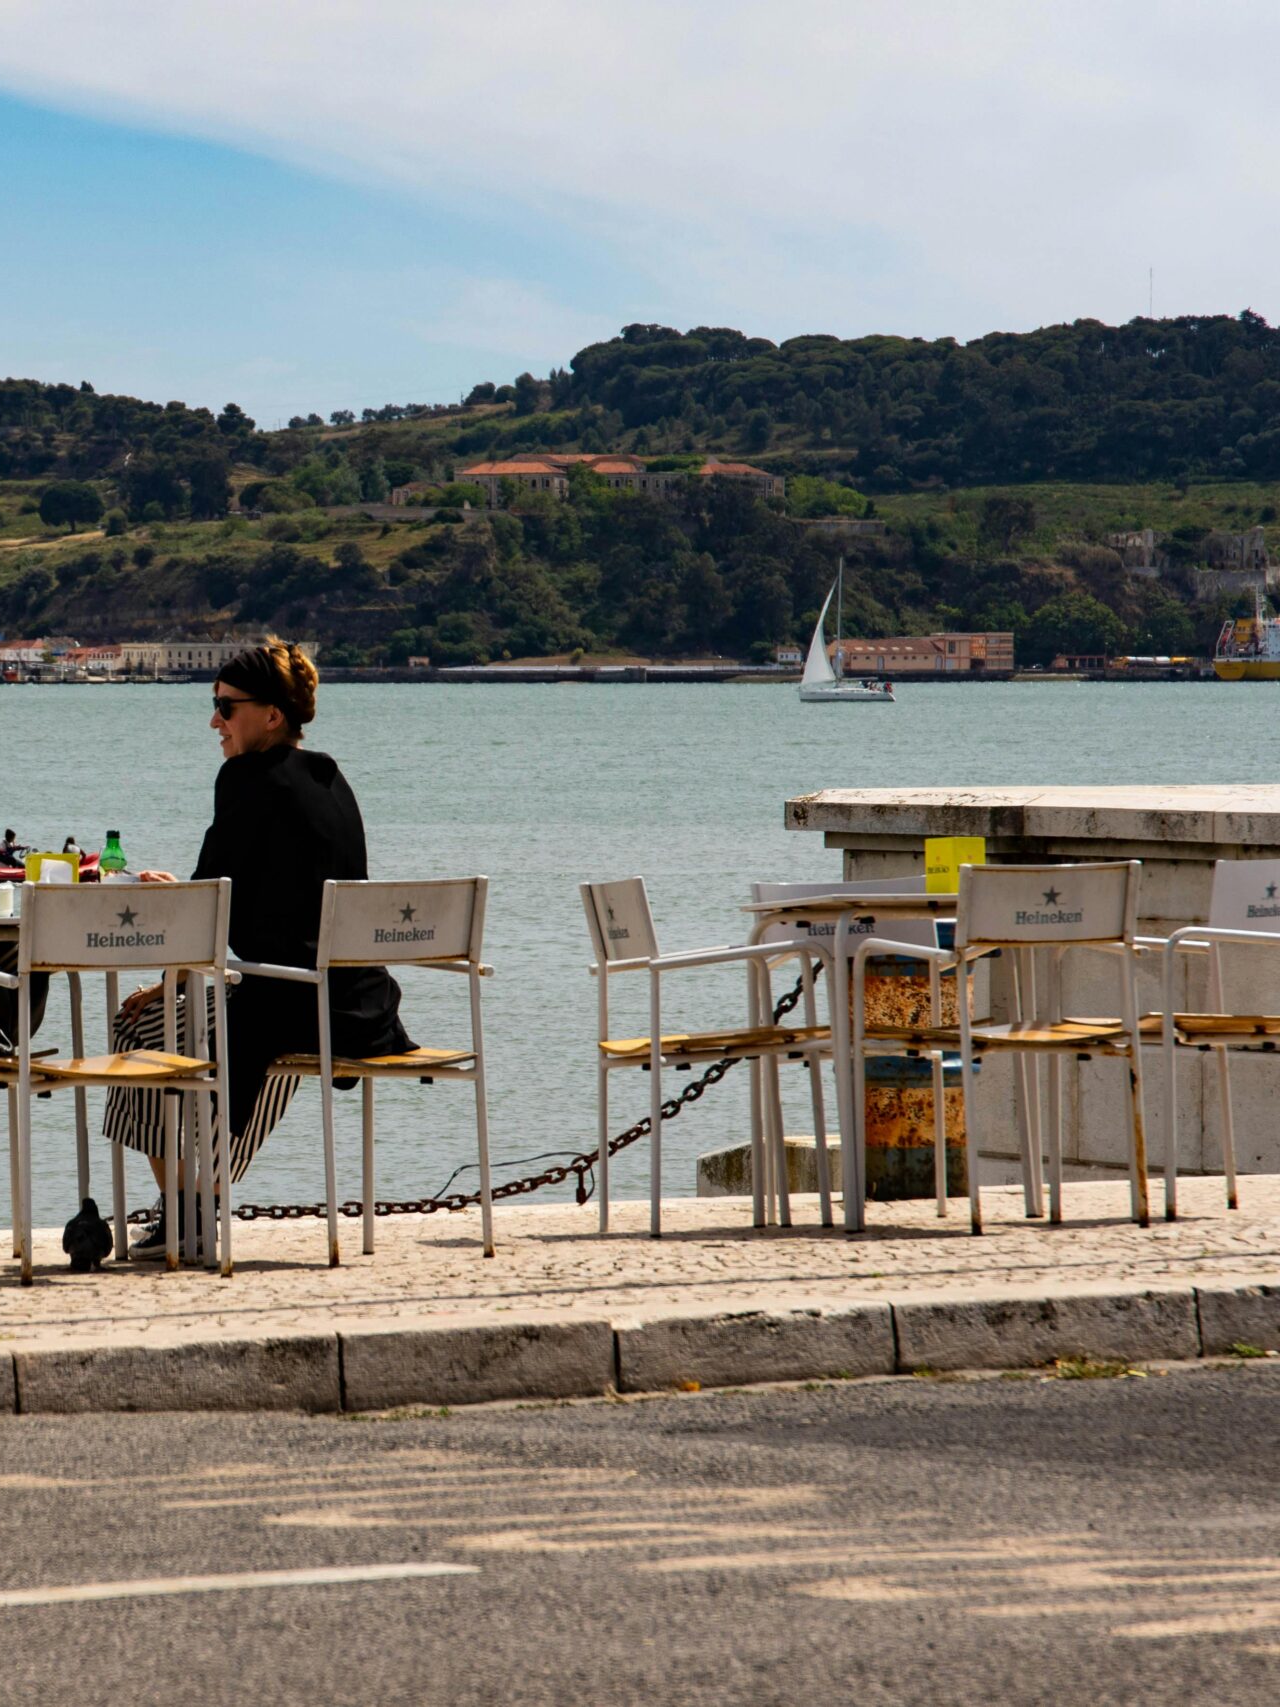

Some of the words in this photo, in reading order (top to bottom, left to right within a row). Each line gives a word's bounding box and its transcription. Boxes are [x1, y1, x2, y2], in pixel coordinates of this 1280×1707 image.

[1015, 910, 1083, 925] Heineken
[1247, 904, 1280, 918] Heinek
[374, 927, 435, 943] Heineken
[808, 922, 876, 936] Heinken
[86, 932, 165, 948] Heineken
